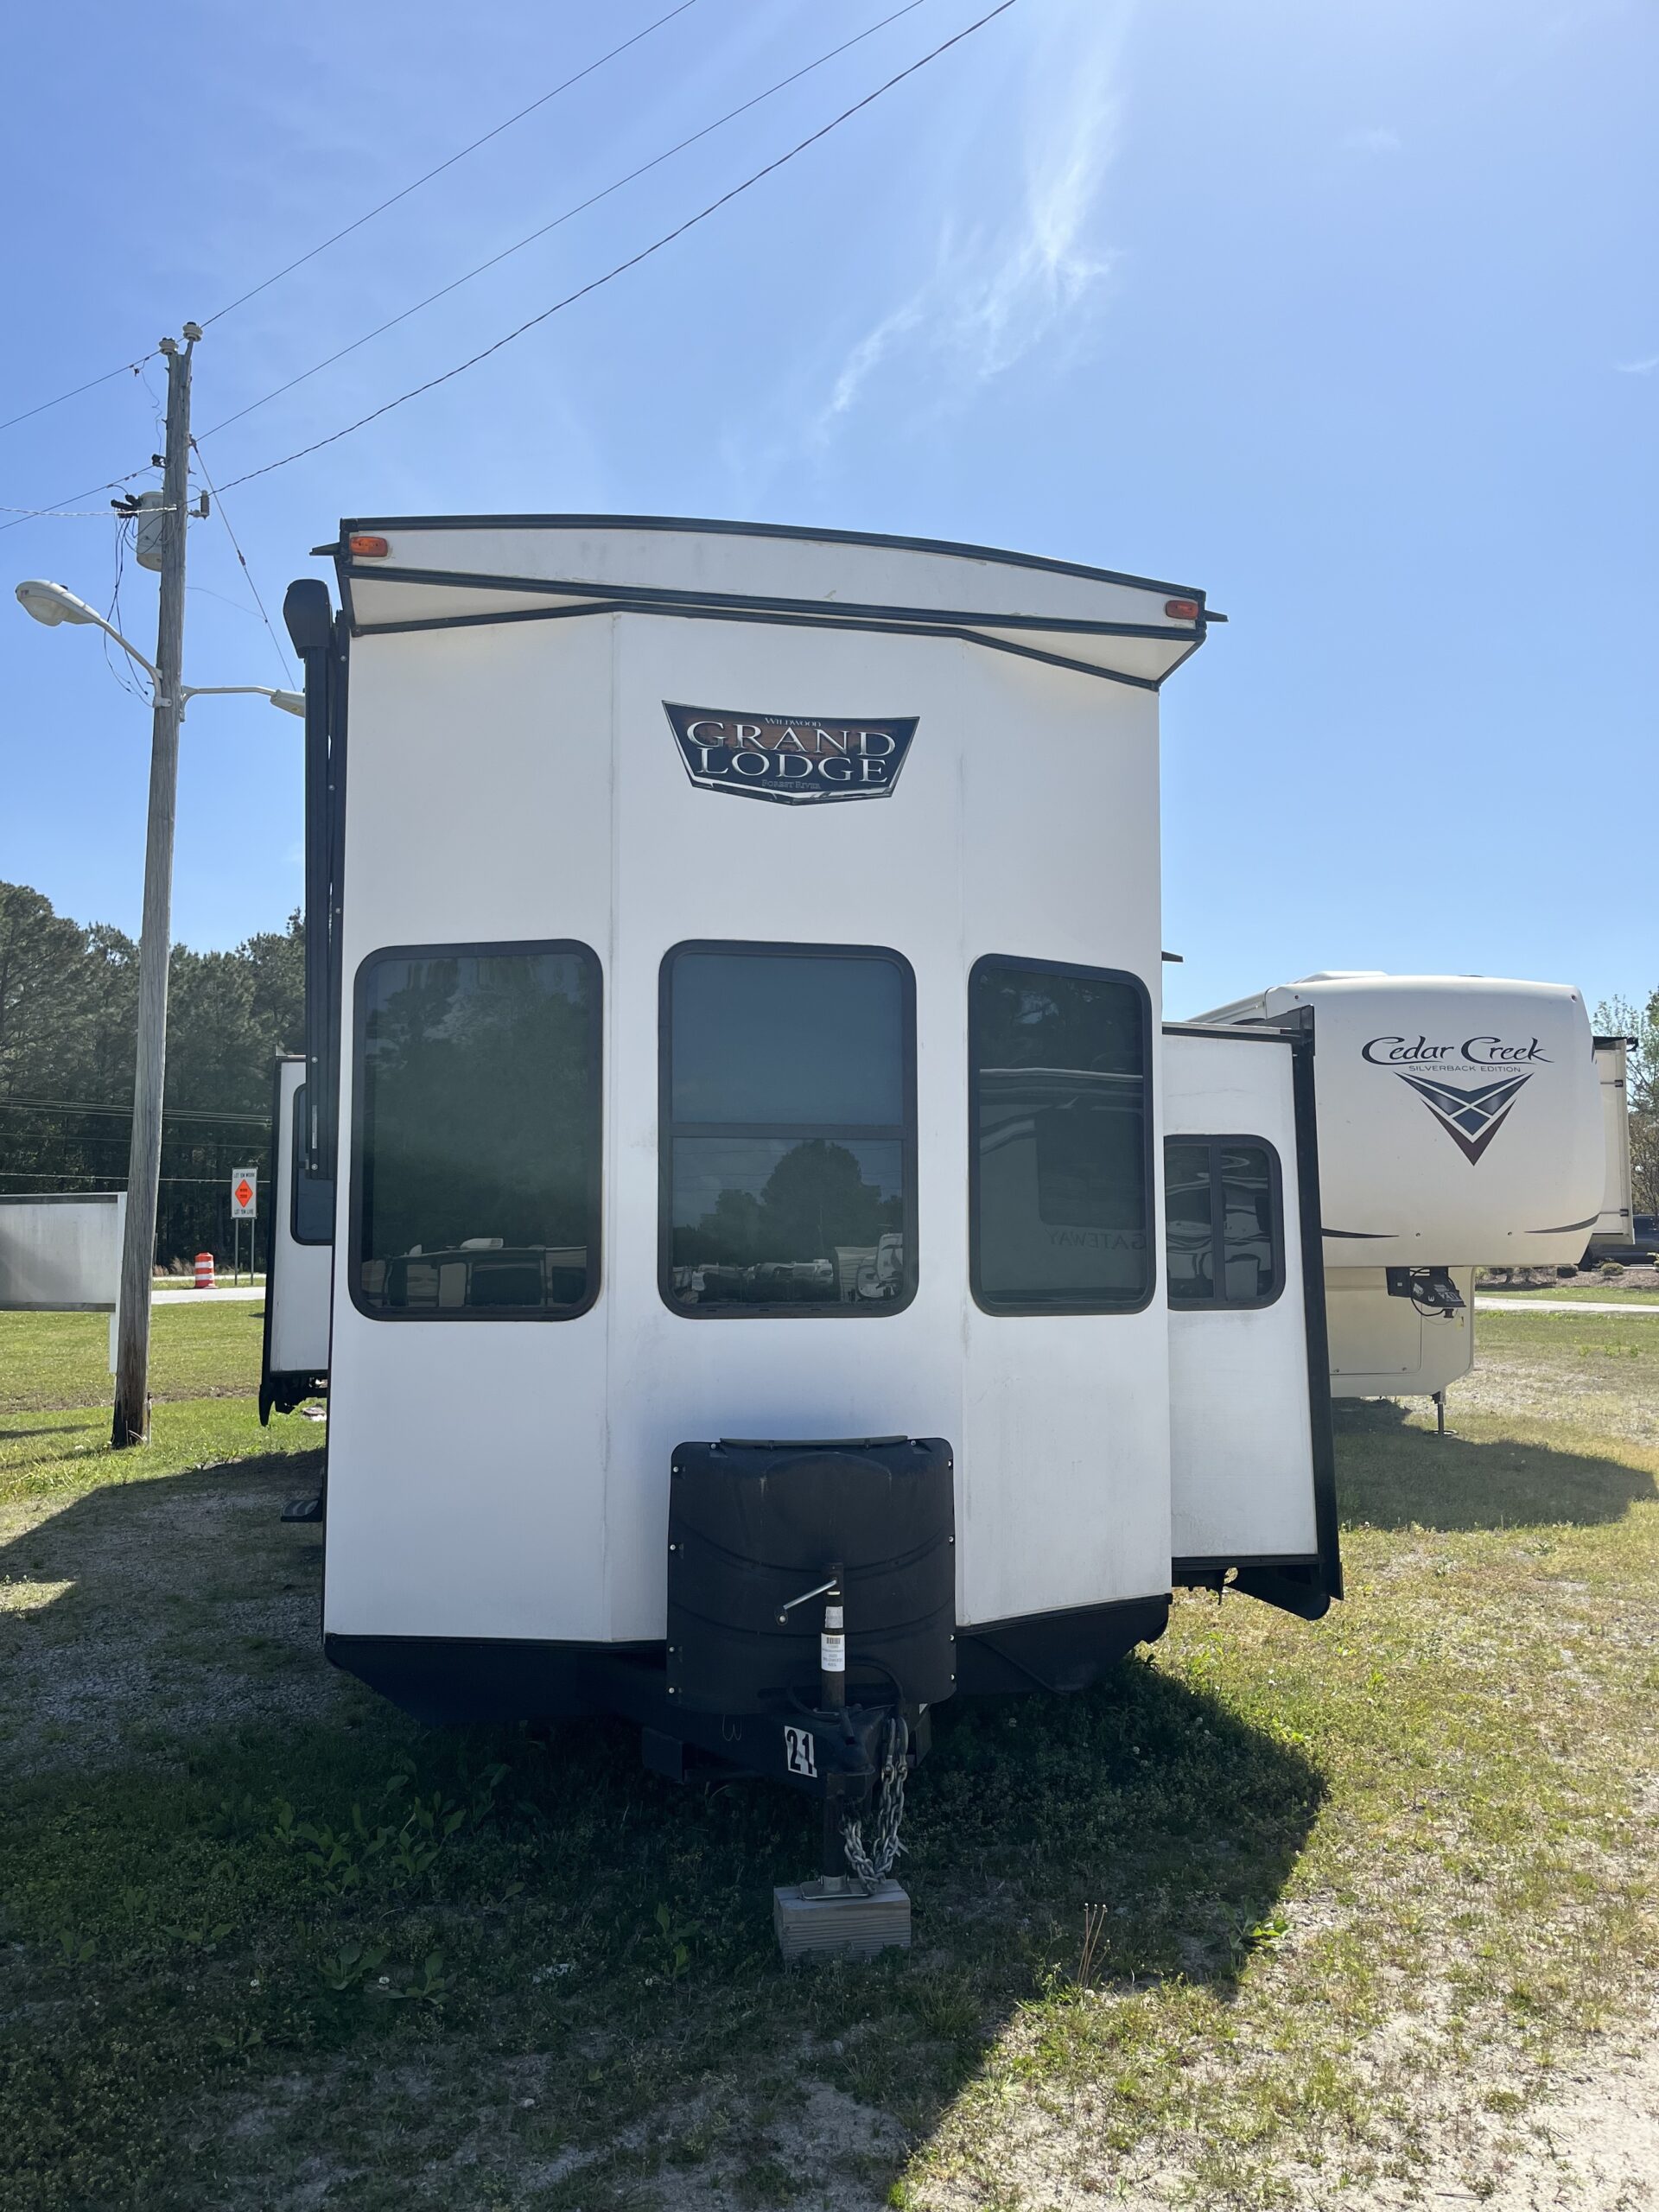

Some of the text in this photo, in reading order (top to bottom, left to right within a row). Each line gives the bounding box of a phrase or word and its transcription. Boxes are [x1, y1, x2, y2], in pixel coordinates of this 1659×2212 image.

[686, 721, 896, 757] GRAND
[765, 717, 822, 728] WILDWOOD
[696, 747, 888, 783] LODGE
[1361, 1035, 1555, 1065] Cedar Creek
[786, 1729, 813, 1774] 21
